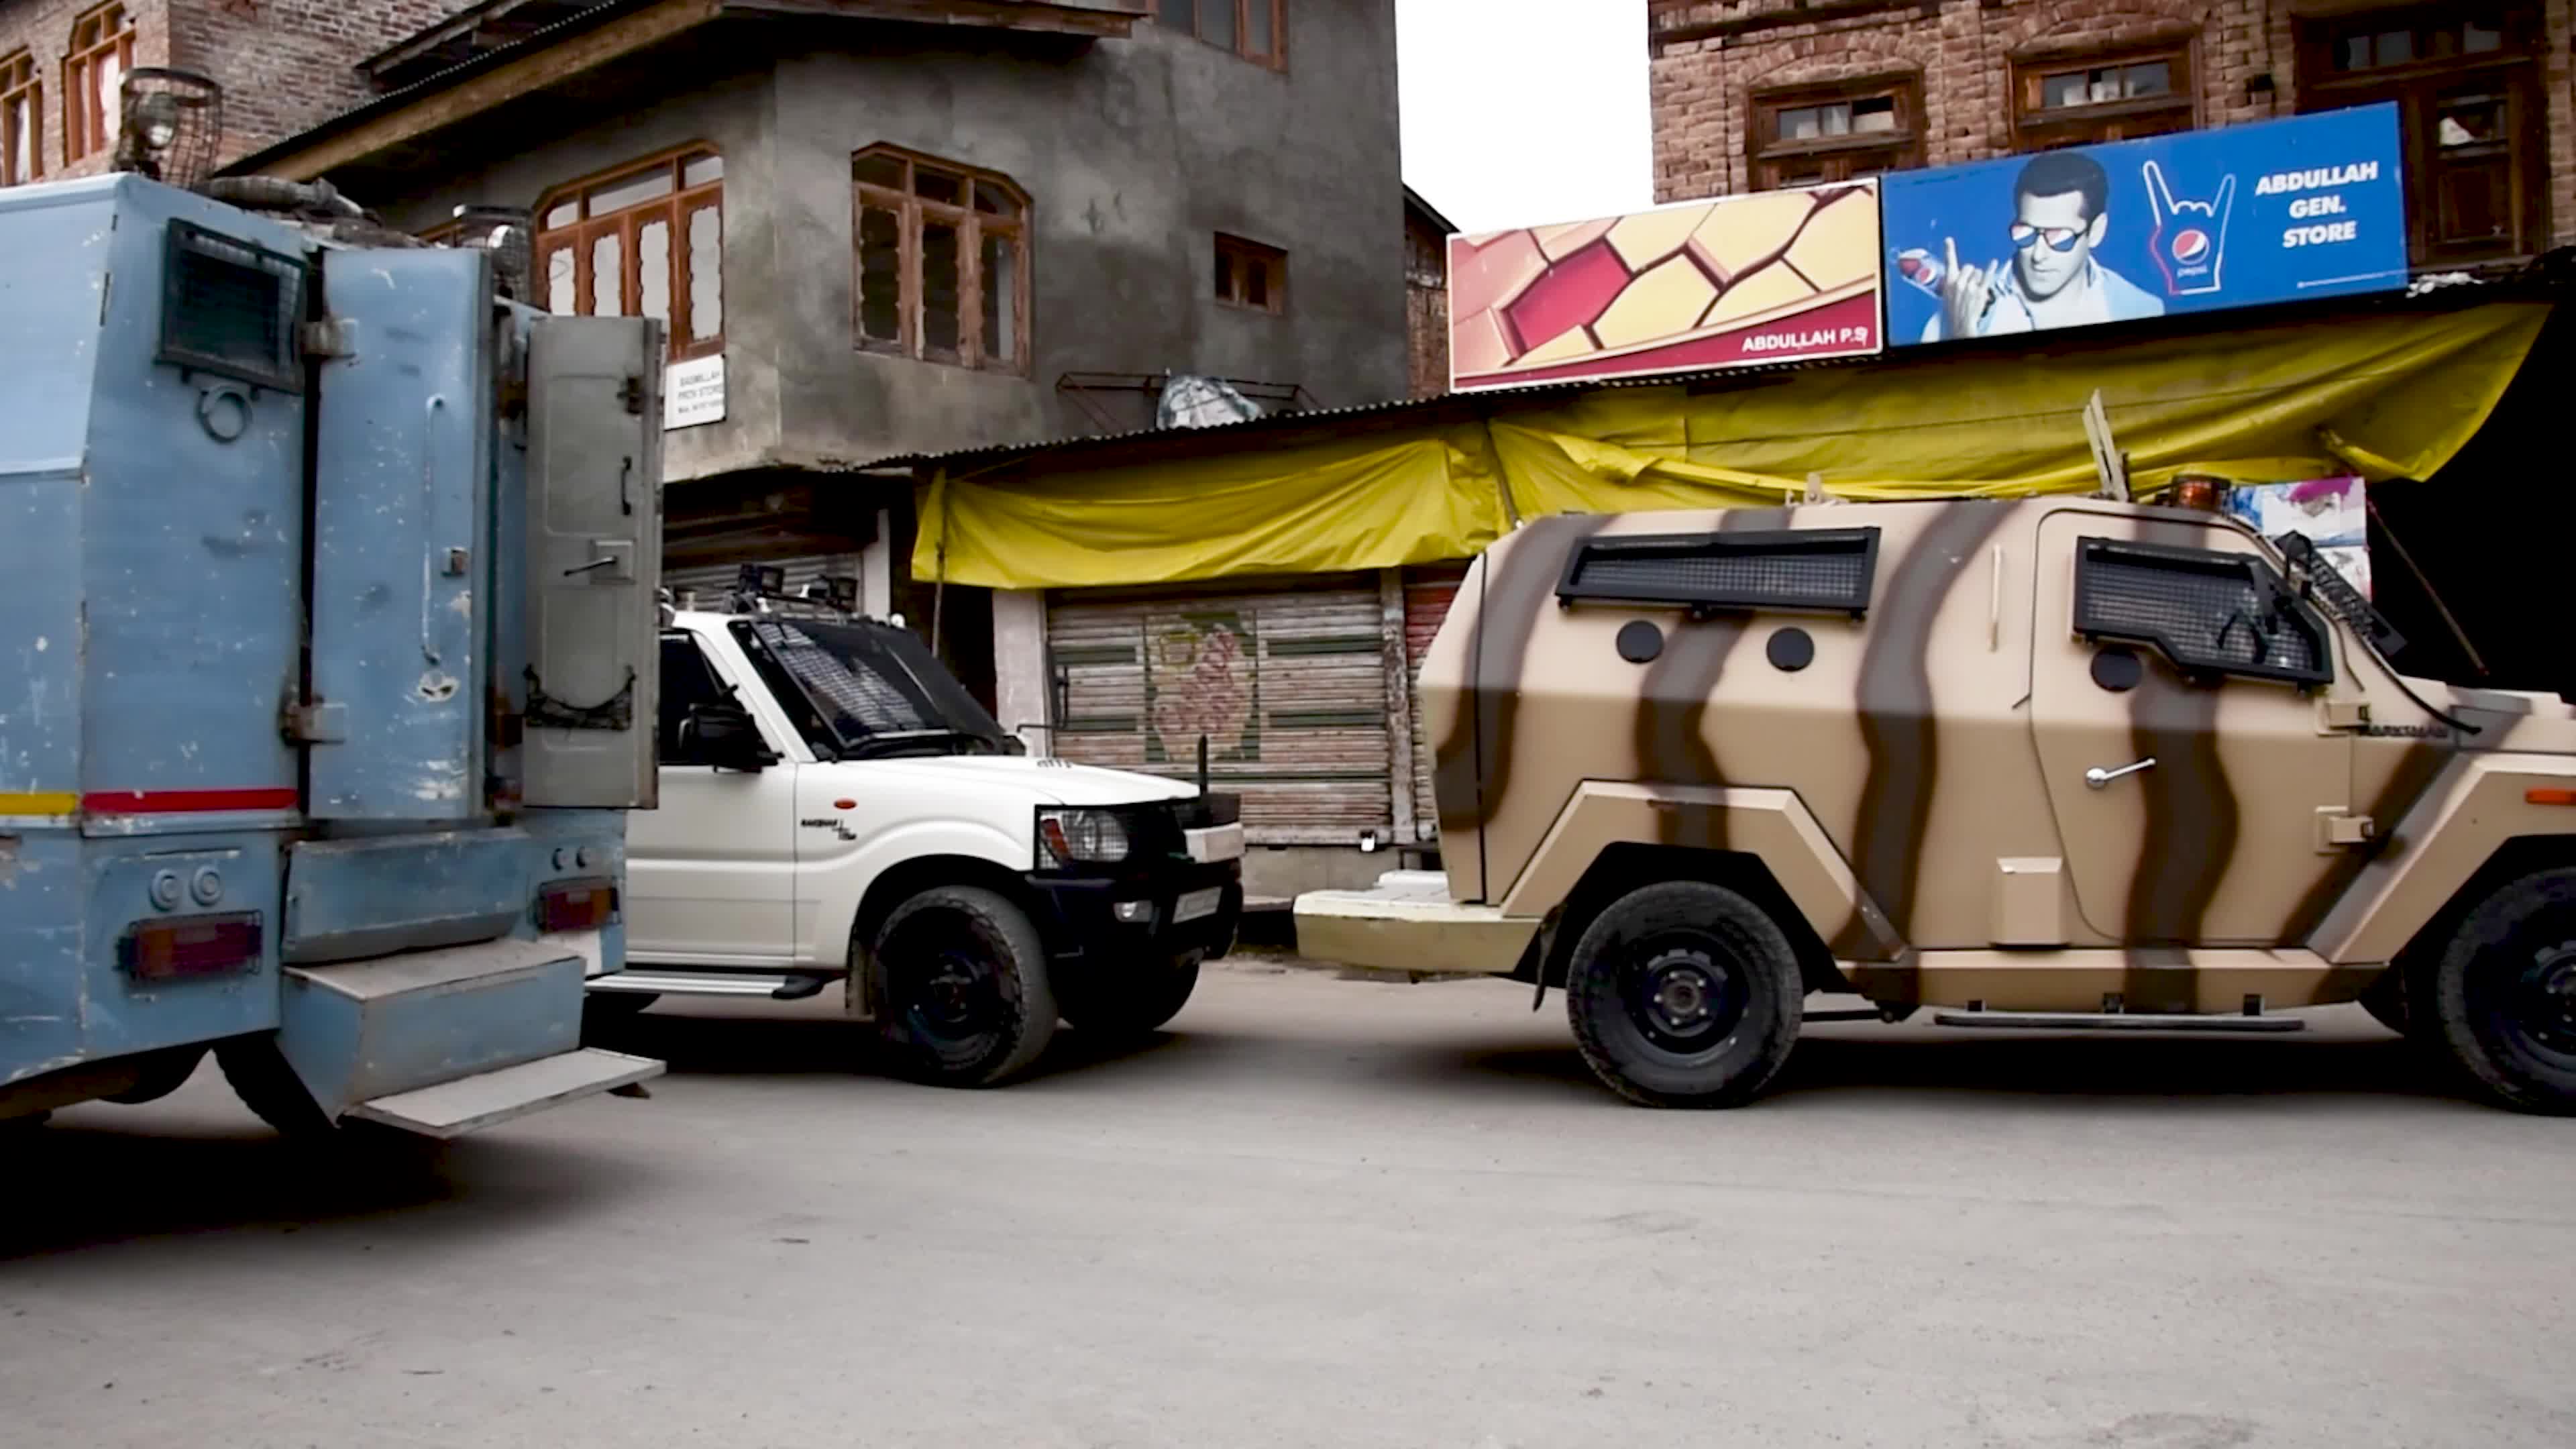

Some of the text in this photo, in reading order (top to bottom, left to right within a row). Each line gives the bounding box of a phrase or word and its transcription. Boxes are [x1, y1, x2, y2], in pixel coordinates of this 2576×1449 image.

[2255, 160, 2379, 196] ABDULLAH
[2288, 195, 2347, 219] GEN.
[2282, 220, 2357, 249] STORE
[1741, 329, 1837, 353] ABDULLAH
